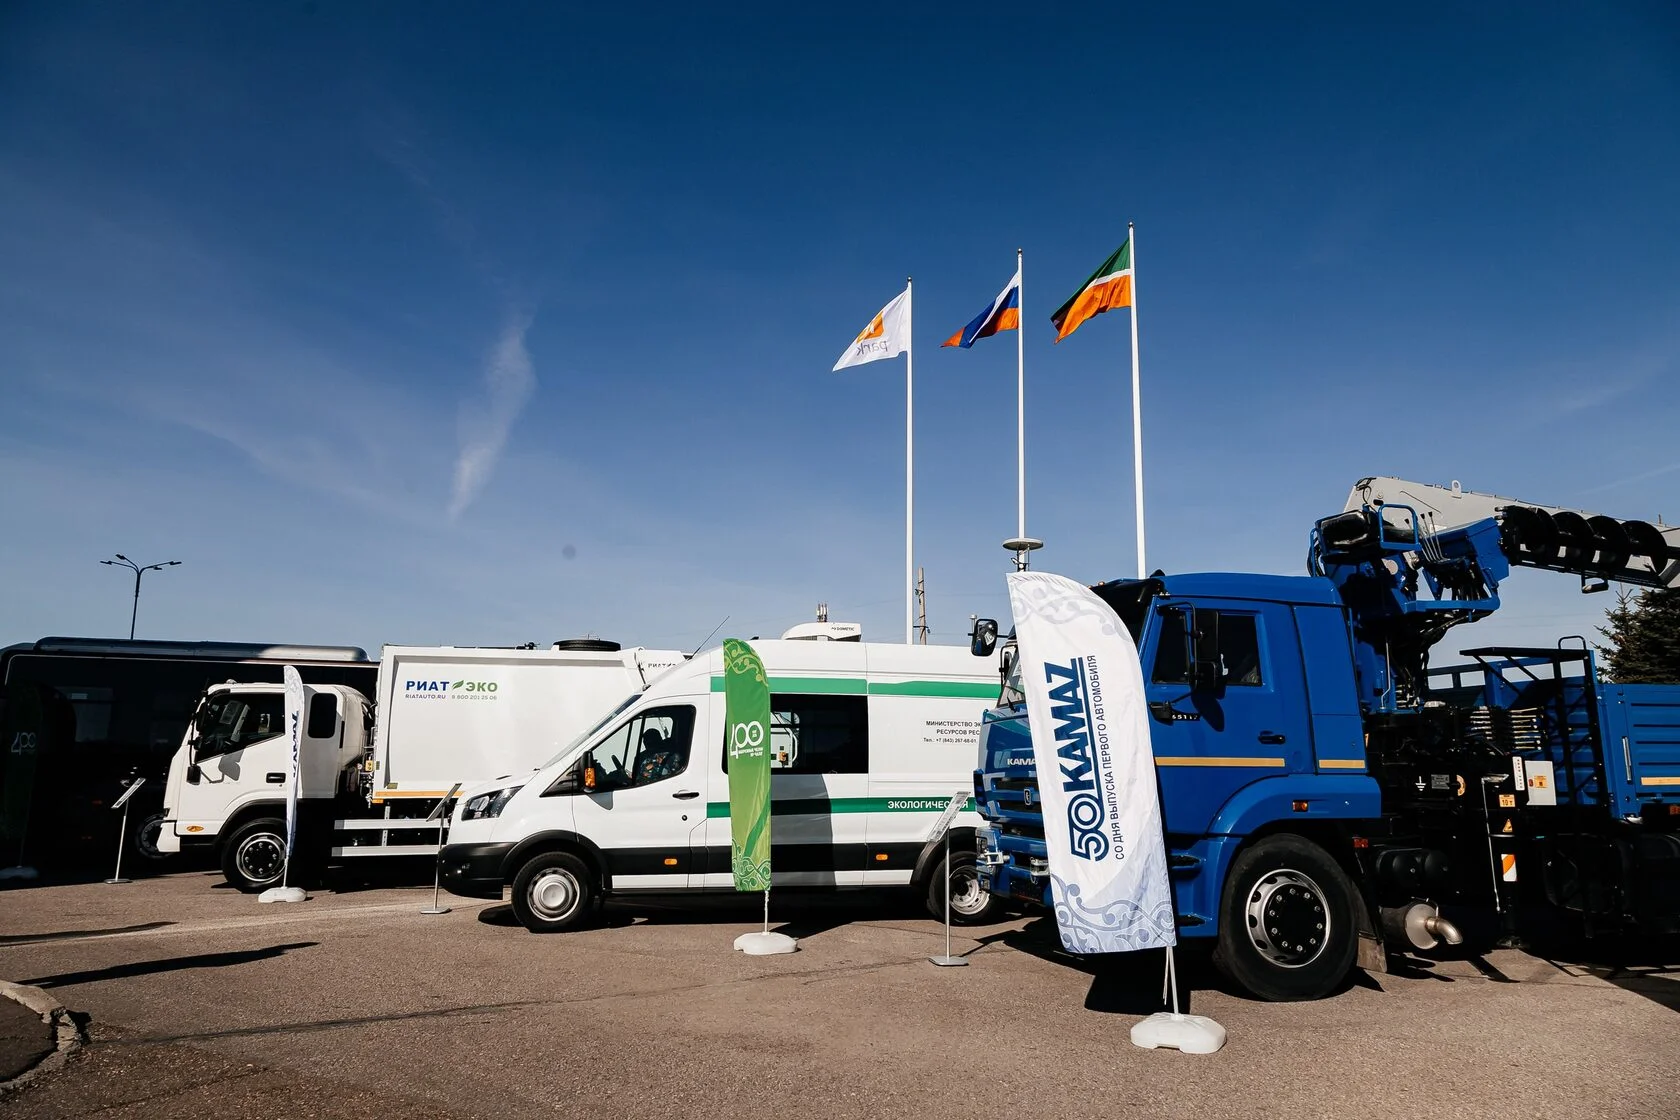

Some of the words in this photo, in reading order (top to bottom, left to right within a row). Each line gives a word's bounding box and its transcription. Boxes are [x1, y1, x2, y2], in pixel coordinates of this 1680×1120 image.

[406, 680, 450, 691] РИАТ
[465, 681, 498, 692] ЭКО
[1086, 655, 1106, 721] АВТОМОБИЛЯ
[1044, 657, 1096, 793] KAMAZ
[1096, 723, 1113, 770] ПЕРВОГО
[887, 800, 968, 809] ЭКОЛОГИЧЕСЯ
[1104, 771, 1119, 820] ВЫПУСКА
[1111, 822, 1124, 843] ДНЯ
[1114, 845, 1125, 860] СО
